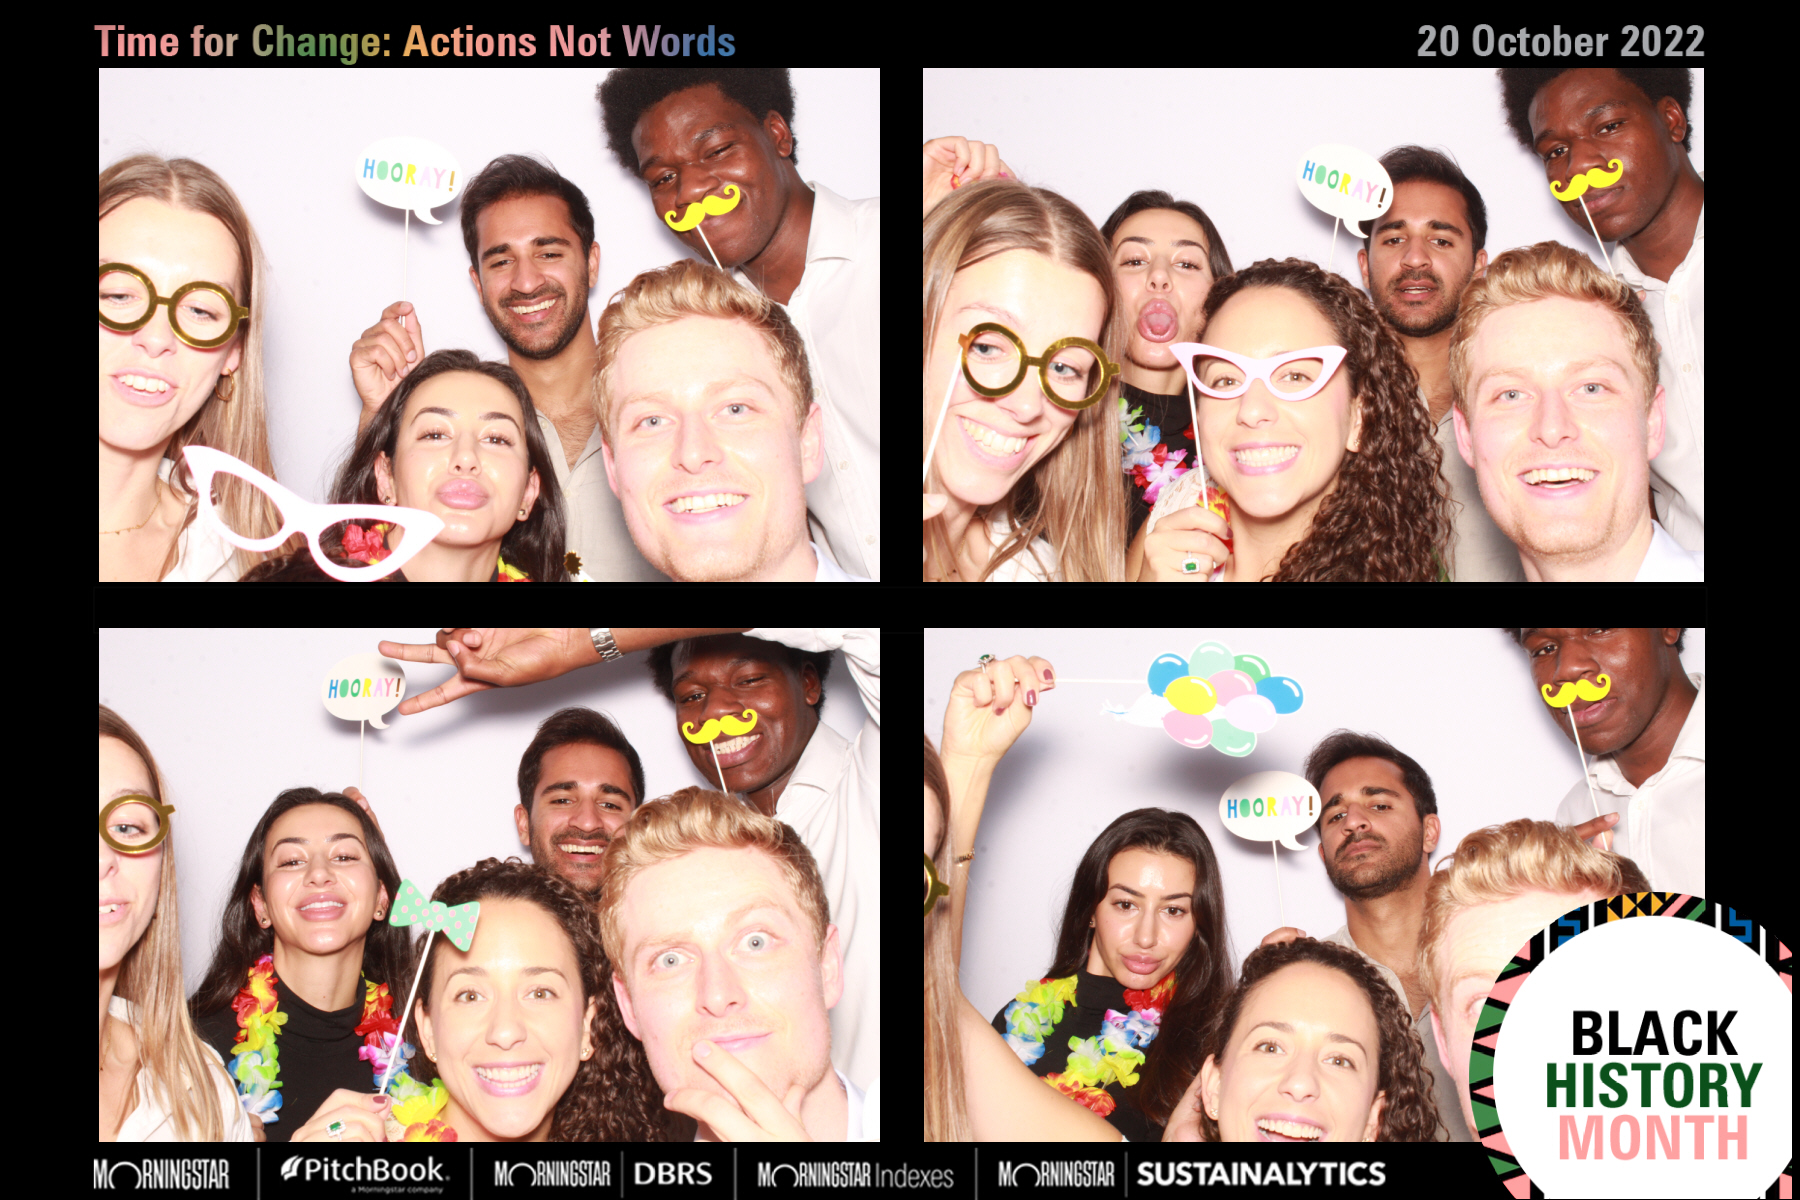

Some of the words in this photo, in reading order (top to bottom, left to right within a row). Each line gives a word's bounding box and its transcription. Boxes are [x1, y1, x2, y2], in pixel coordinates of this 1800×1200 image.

[363, 158, 455, 192] HOORAY!
[1302, 160, 1387, 208] HOORAY!
[328, 677, 401, 699] HOORAY!
[1227, 795, 1313, 819] HOORAY!
